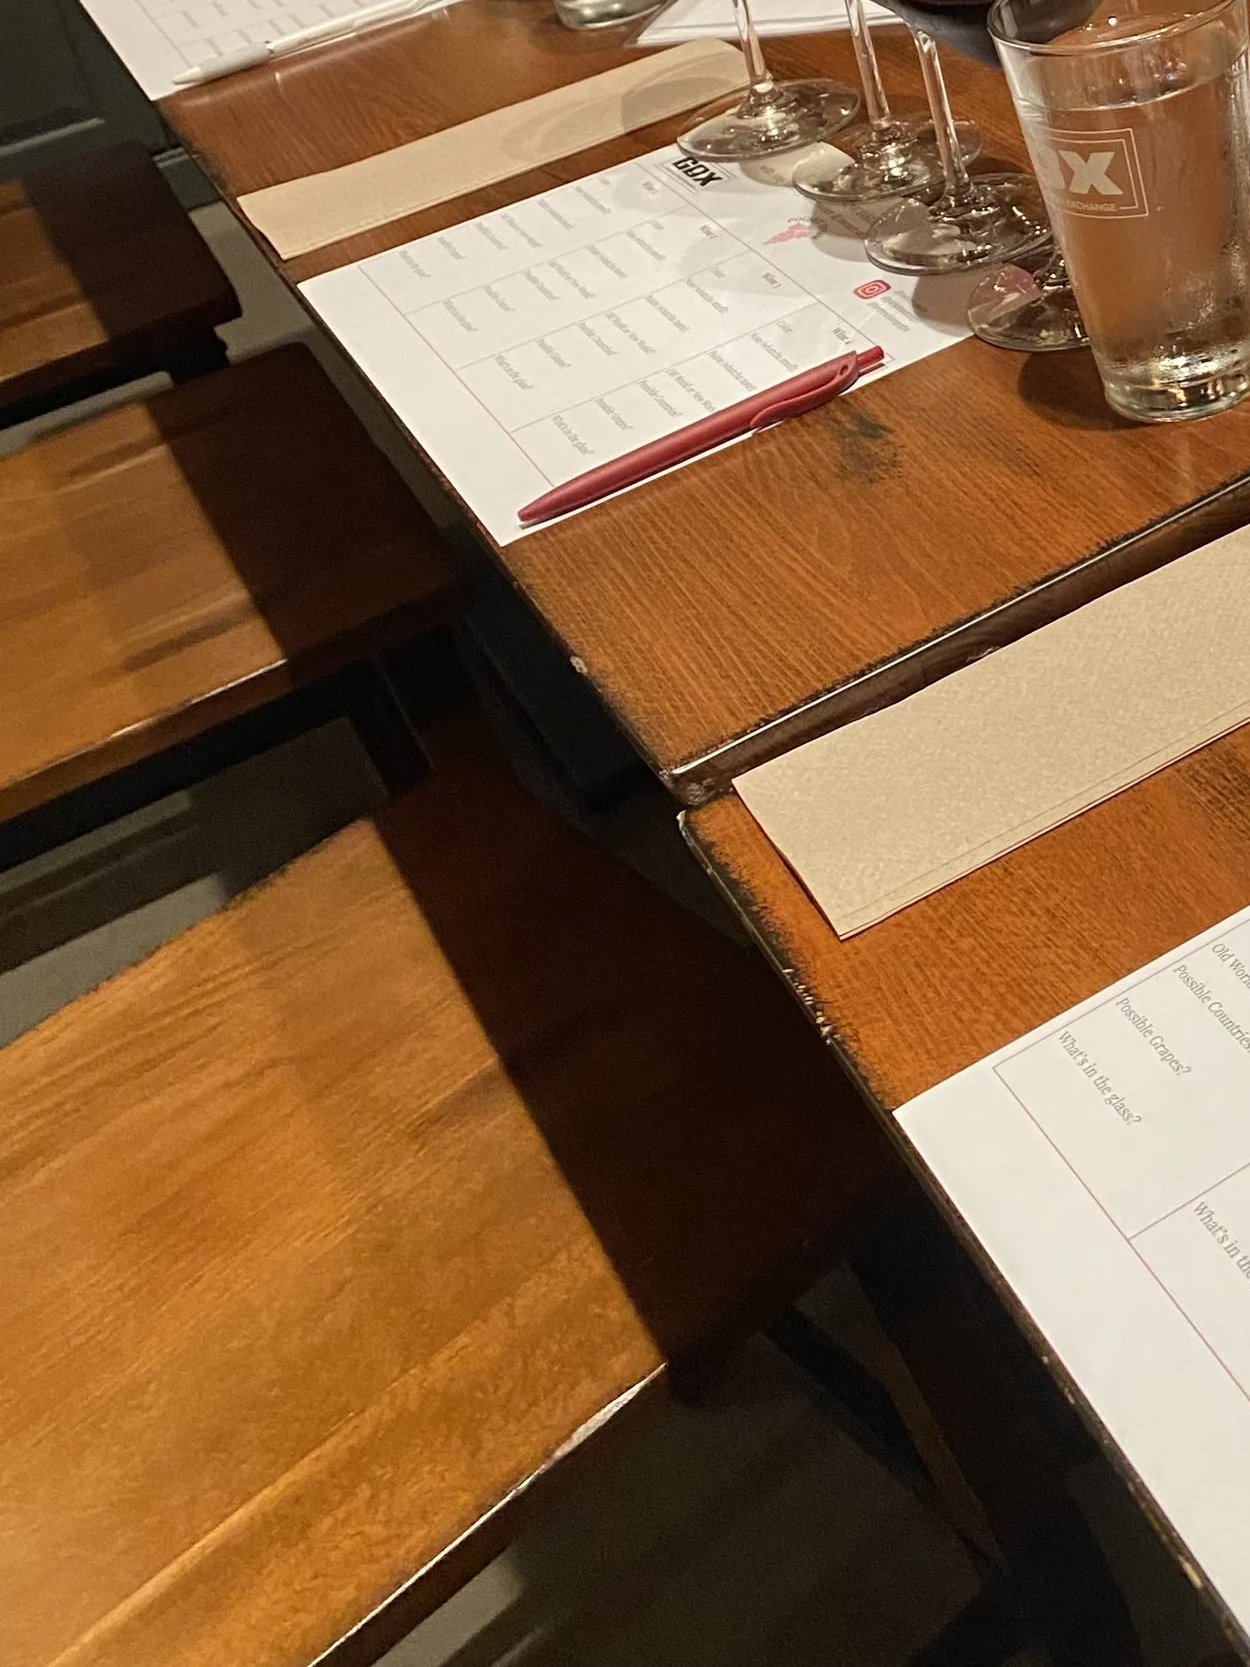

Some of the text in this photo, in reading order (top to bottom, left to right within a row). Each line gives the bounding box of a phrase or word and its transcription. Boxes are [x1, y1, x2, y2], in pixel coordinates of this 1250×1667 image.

[1211, 943, 1235, 962] Old
[1171, 964, 1211, 1004] Possible
[1115, 997, 1191, 1076] Possible Grapes?
[1058, 1030, 1141, 1125] What's in the glass?
[1193, 1201, 1229, 1245] What's
[1222, 1240, 1240, 1259] in
